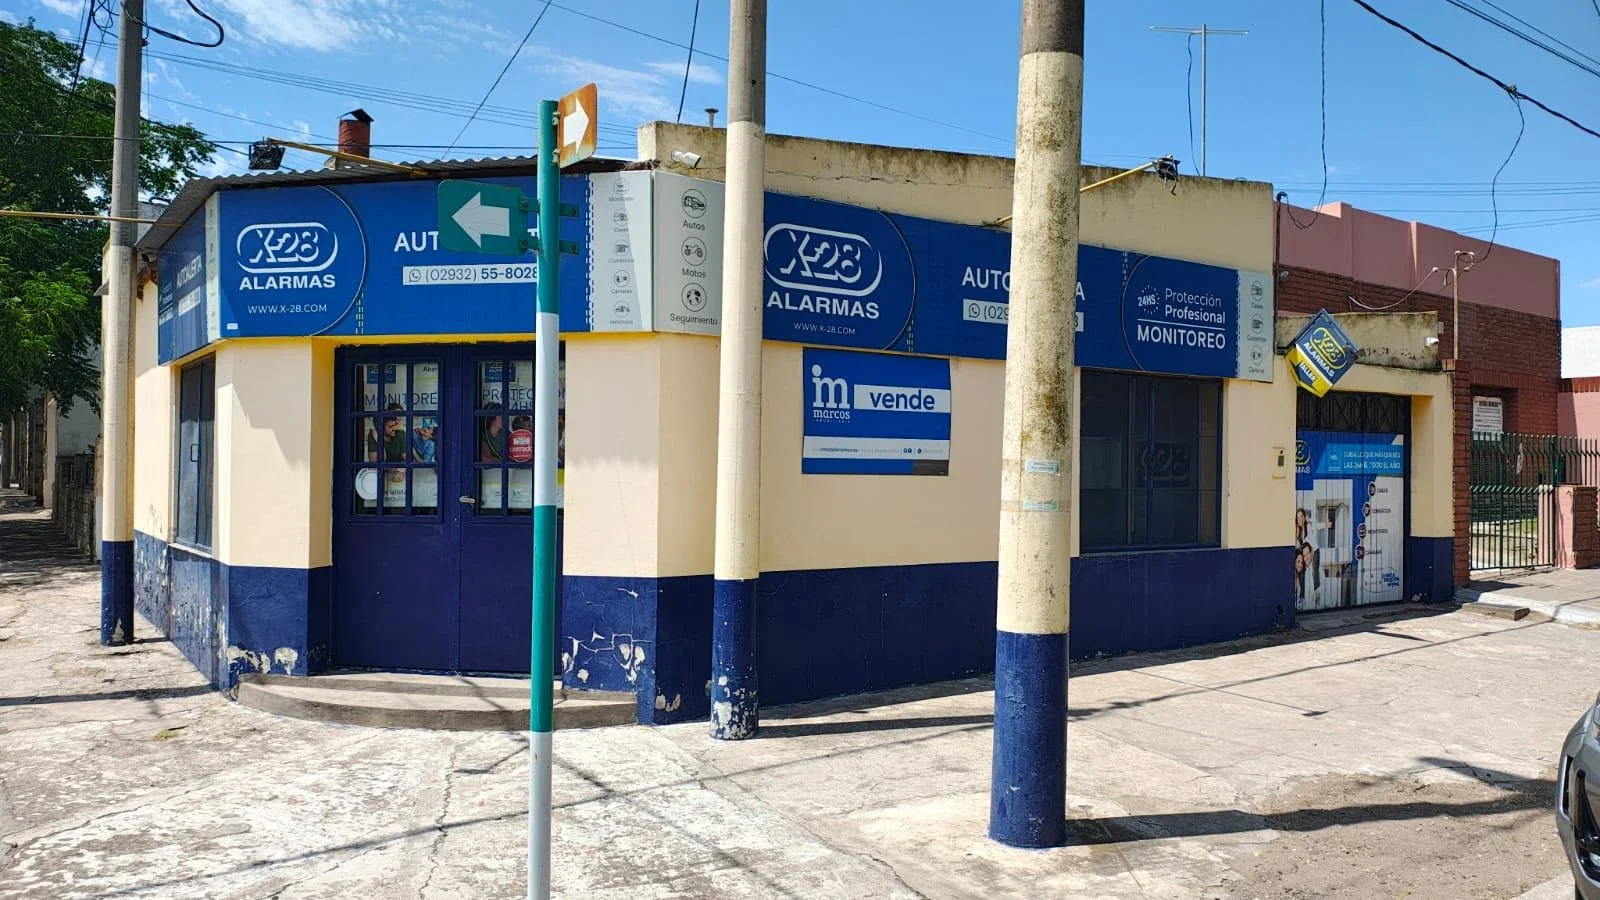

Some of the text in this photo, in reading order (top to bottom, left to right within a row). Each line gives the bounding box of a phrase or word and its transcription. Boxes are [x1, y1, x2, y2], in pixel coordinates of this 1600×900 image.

[682, 220, 706, 231] Autos
[425, 267, 477, 283] (02932)
[681, 268, 706, 279] Motos
[239, 274, 336, 291] ALARMAS
[767, 291, 880, 320] ALARMAS
[1165, 288, 1222, 308] Protección
[247, 303, 327, 314] WWW.X-28.COM
[1165, 306, 1226, 325] Profesional
[669, 313, 718, 326] Seguimiento
[793, 321, 856, 336] WWW.X-28.COM
[1137, 324, 1226, 350] MONITOREO
[869, 389, 935, 410] vende
[812, 409, 851, 420] marcos
